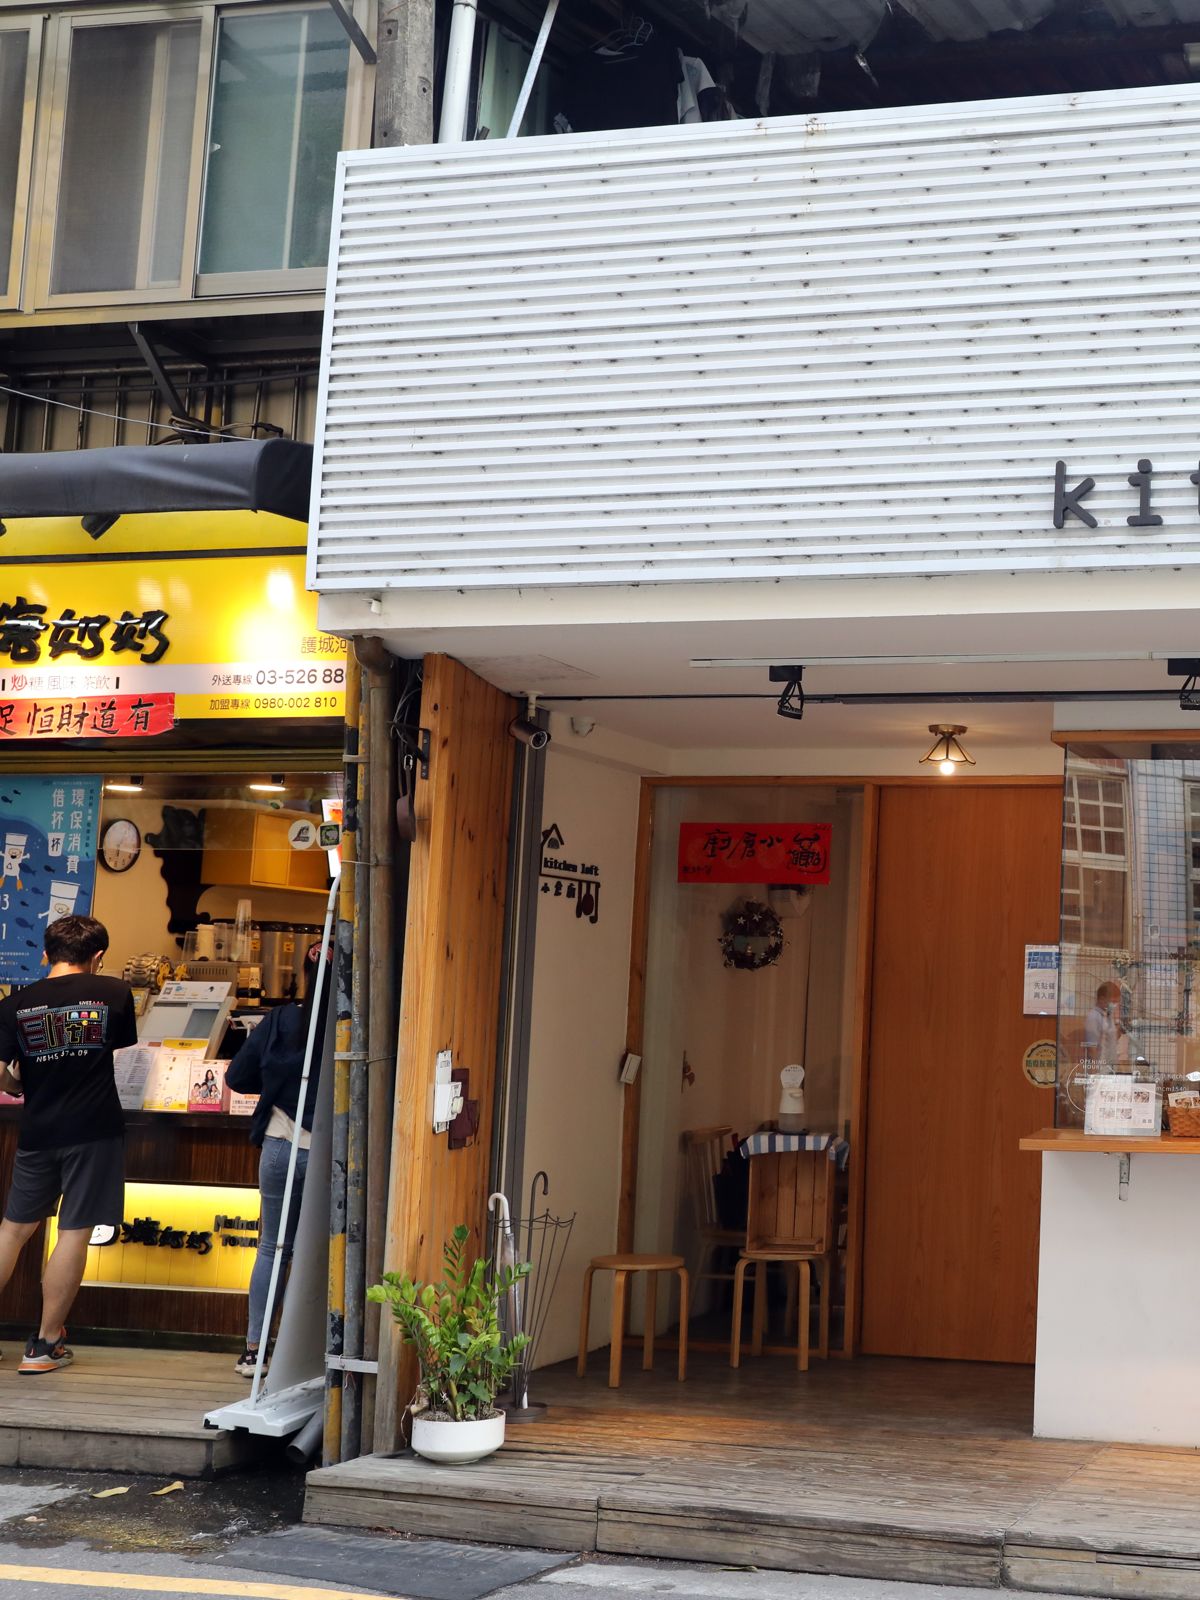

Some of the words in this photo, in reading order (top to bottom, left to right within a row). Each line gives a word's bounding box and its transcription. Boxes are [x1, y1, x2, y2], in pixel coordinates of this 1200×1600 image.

[212, 674, 252, 686] 外送專線
[256, 669, 317, 685] 03-526
[322, 667, 347, 684] 88
[209, 698, 251, 711] 加盟專線
[314, 696, 338, 708] 810
[544, 857, 578, 873] kitchen
[580, 863, 599, 876] loft
